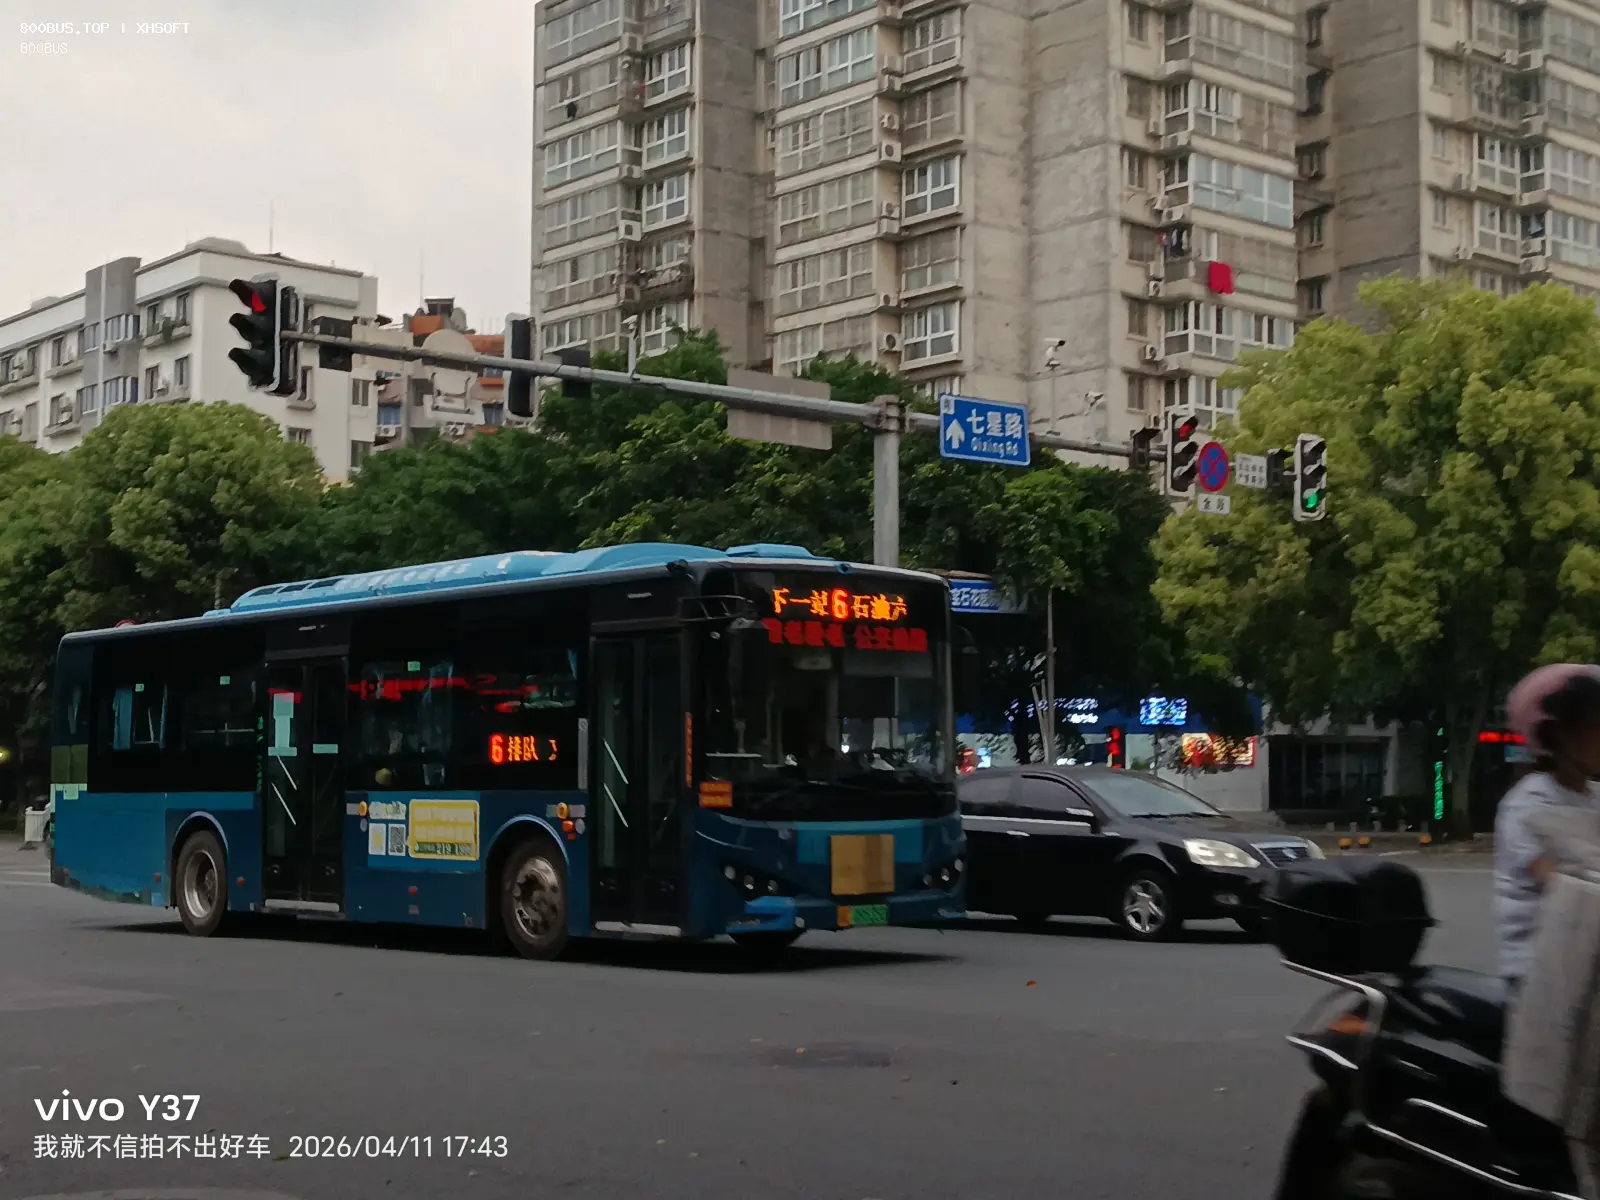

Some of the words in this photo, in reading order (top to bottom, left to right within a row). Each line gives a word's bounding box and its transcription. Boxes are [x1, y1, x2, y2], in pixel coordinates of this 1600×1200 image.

[966, 408, 1023, 439] 七星路
[831, 586, 850, 621] 6
[489, 733, 504, 764] 6
